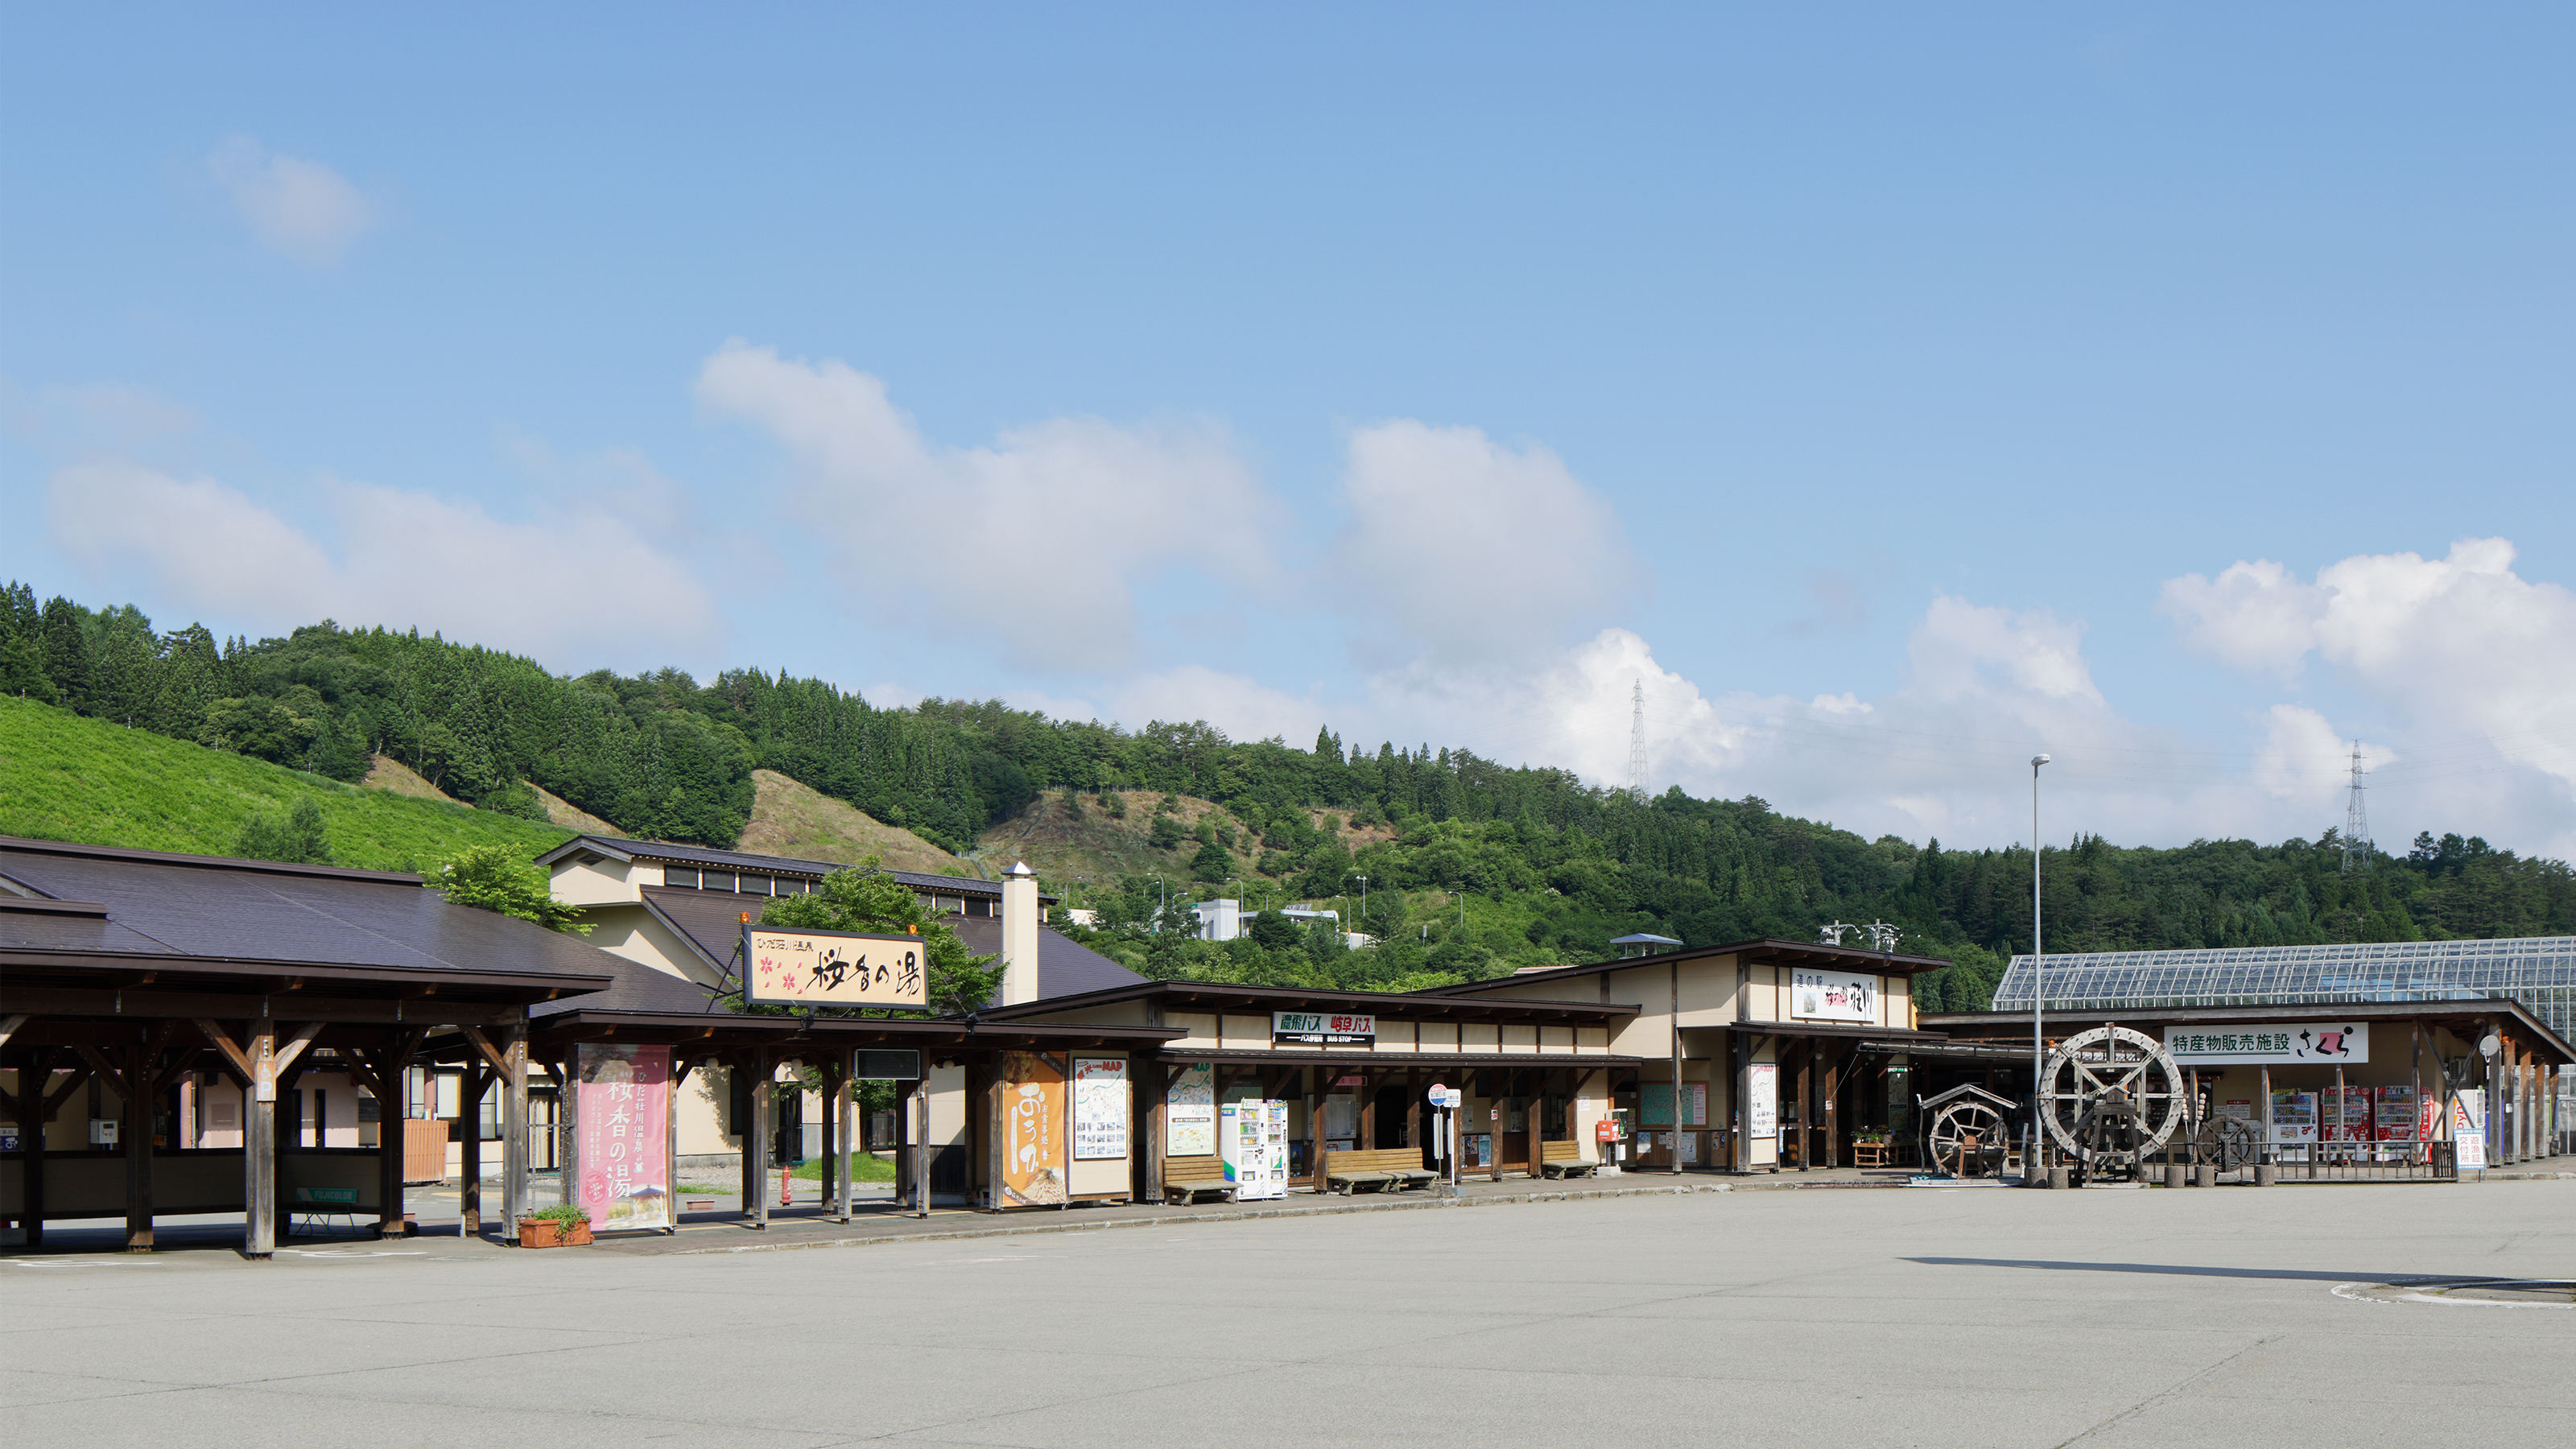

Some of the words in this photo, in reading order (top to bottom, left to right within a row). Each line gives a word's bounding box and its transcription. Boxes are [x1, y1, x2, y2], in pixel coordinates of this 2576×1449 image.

[757, 938, 814, 952] ひだ荘川温泉
[805, 946, 921, 997] 桜香の湯
[1797, 973, 1823, 989] 道の駅
[1280, 1013, 1322, 1031] 濃飛バス
[1330, 1015, 1371, 1033] 岐阜バス
[1327, 1034, 1338, 1042] BUS
[2173, 1034, 2290, 1052] 特産物販売施設
[2297, 1026, 2354, 1058] さくら
[1101, 1060, 1123, 1071] MAP
[633, 1071, 647, 1153] ひだ荘川温泉
[605, 1071, 635, 1199] 桜香の湯
[2458, 1136, 2470, 1163] 交付所
[2471, 1136, 2481, 1163] 遊漁証
[315, 1191, 353, 1200] FUJICOLOR
